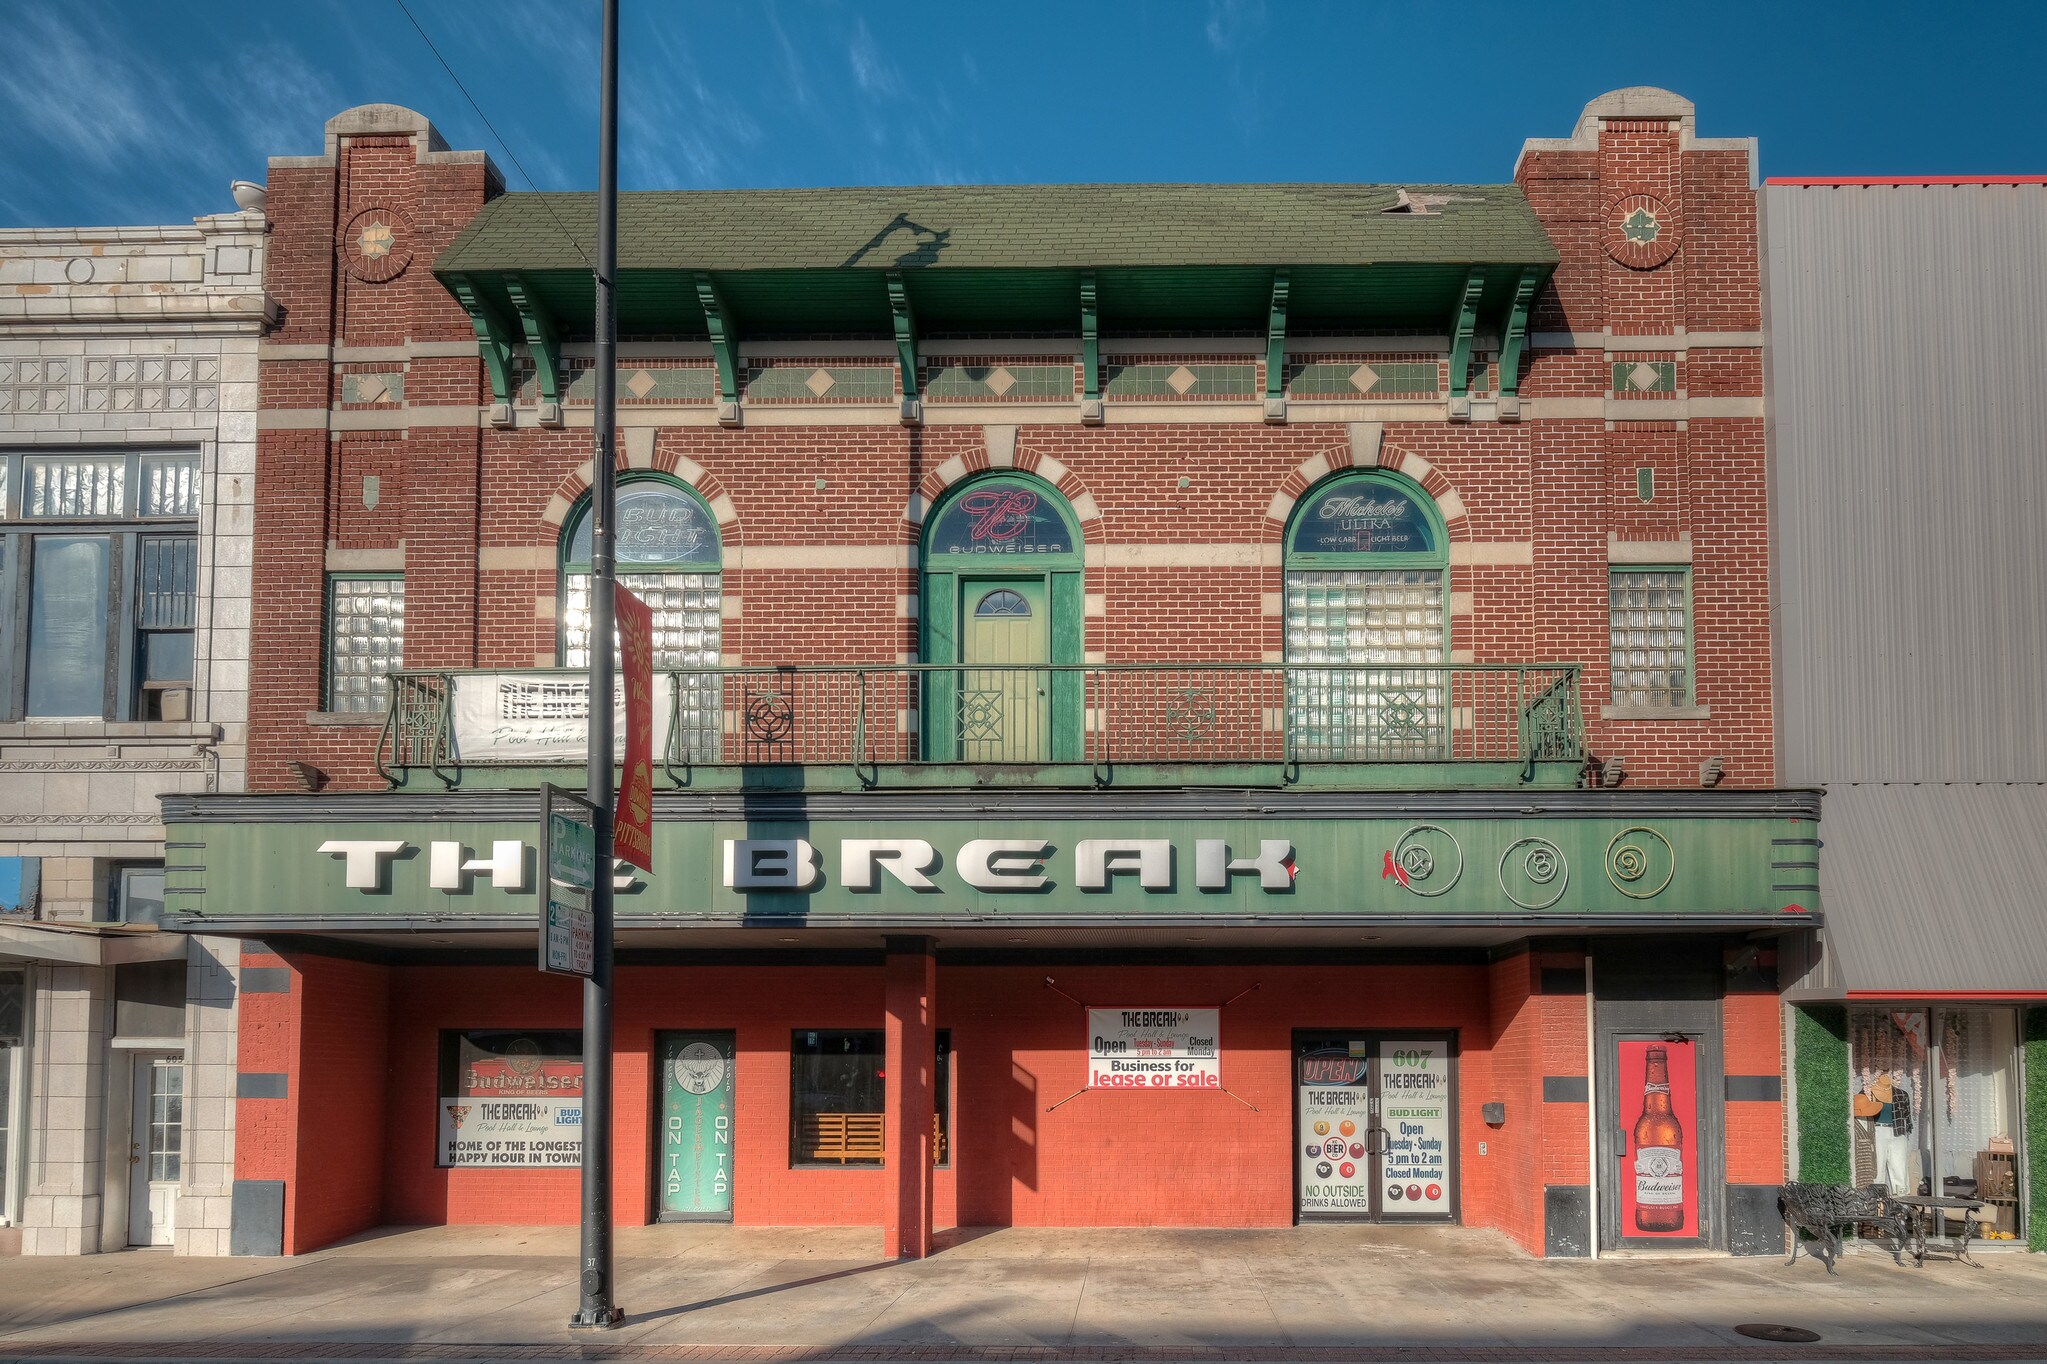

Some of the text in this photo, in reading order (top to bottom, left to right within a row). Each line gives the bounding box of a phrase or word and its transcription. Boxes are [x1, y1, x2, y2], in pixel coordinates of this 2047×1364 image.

[622, 507, 695, 522] BUD
[1319, 496, 1408, 519] Michelob
[1341, 518, 1391, 531] ULTRA
[620, 526, 705, 543] IGHT
[1320, 536, 1336, 544] LOW
[1371, 535, 1391, 543] LIGHT
[950, 543, 1063, 554] BUDWEISER
[553, 816, 591, 865] PARKING
[723, 839, 1291, 888] BREAK
[1533, 852, 1551, 875] 8
[1620, 852, 1640, 876] 9
[550, 905, 555, 922] 2
[1122, 1011, 1177, 1027] THE BREAK
[1118, 1029, 1138, 1039] Pool
[1140, 1029, 1158, 1039] Hall
[1166, 1029, 1191, 1040] Lounge
[1189, 1036, 1213, 1046] Closed
[1094, 1036, 1127, 1056] Open
[1133, 1037, 1152, 1048] Tuesday
[1156, 1037, 1175, 1048] Sunday
[166, 1055, 183, 1063] 605
[1187, 1047, 1216, 1057] Monday
[1111, 1060, 1195, 1071] Business for
[1393, 1049, 1433, 1070] 607
[1303, 1057, 1359, 1081] OPEN
[465, 1069, 583, 1089] Budweiser
[1093, 1070, 1218, 1086] lease or sale
[1384, 1073, 1436, 1088] THE BREAK
[1308, 1091, 1356, 1105] THE BREAK
[1381, 1091, 1399, 1099] Pool
[1401, 1090, 1418, 1099] Hall
[481, 1103, 537, 1120] THE BREAK
[560, 1109, 581, 1117] BUD
[1305, 1107, 1322, 1115] Pool
[1324, 1106, 1339, 1115] Hall
[1389, 1109, 1440, 1117] BUD LIGHT
[477, 1122, 497, 1132] Pool
[498, 1122, 517, 1132] Hall
[525, 1122, 549, 1134] Lounge
[668, 1116, 682, 1145] ON
[714, 1116, 728, 1144] ON
[1400, 1121, 1424, 1137] Open
[448, 1141, 582, 1151] HOME OF THE LONGEST
[1417, 1136, 1442, 1152] Sunday
[449, 1152, 581, 1163] HAPPY HOUR IN TOWN
[1388, 1151, 1442, 1165] 5 pm to 2 am
[668, 1153, 681, 1197] TAP
[714, 1153, 728, 1196] TAP
[1386, 1167, 1443, 1180] Closed Monday
[1305, 1185, 1364, 1197] NO OUTSIDE
[1637, 1180, 1681, 1191] Budweiser
[1301, 1198, 1366, 1207] DRINKS ALLOWED
[587, 1257, 596, 1267] 37
